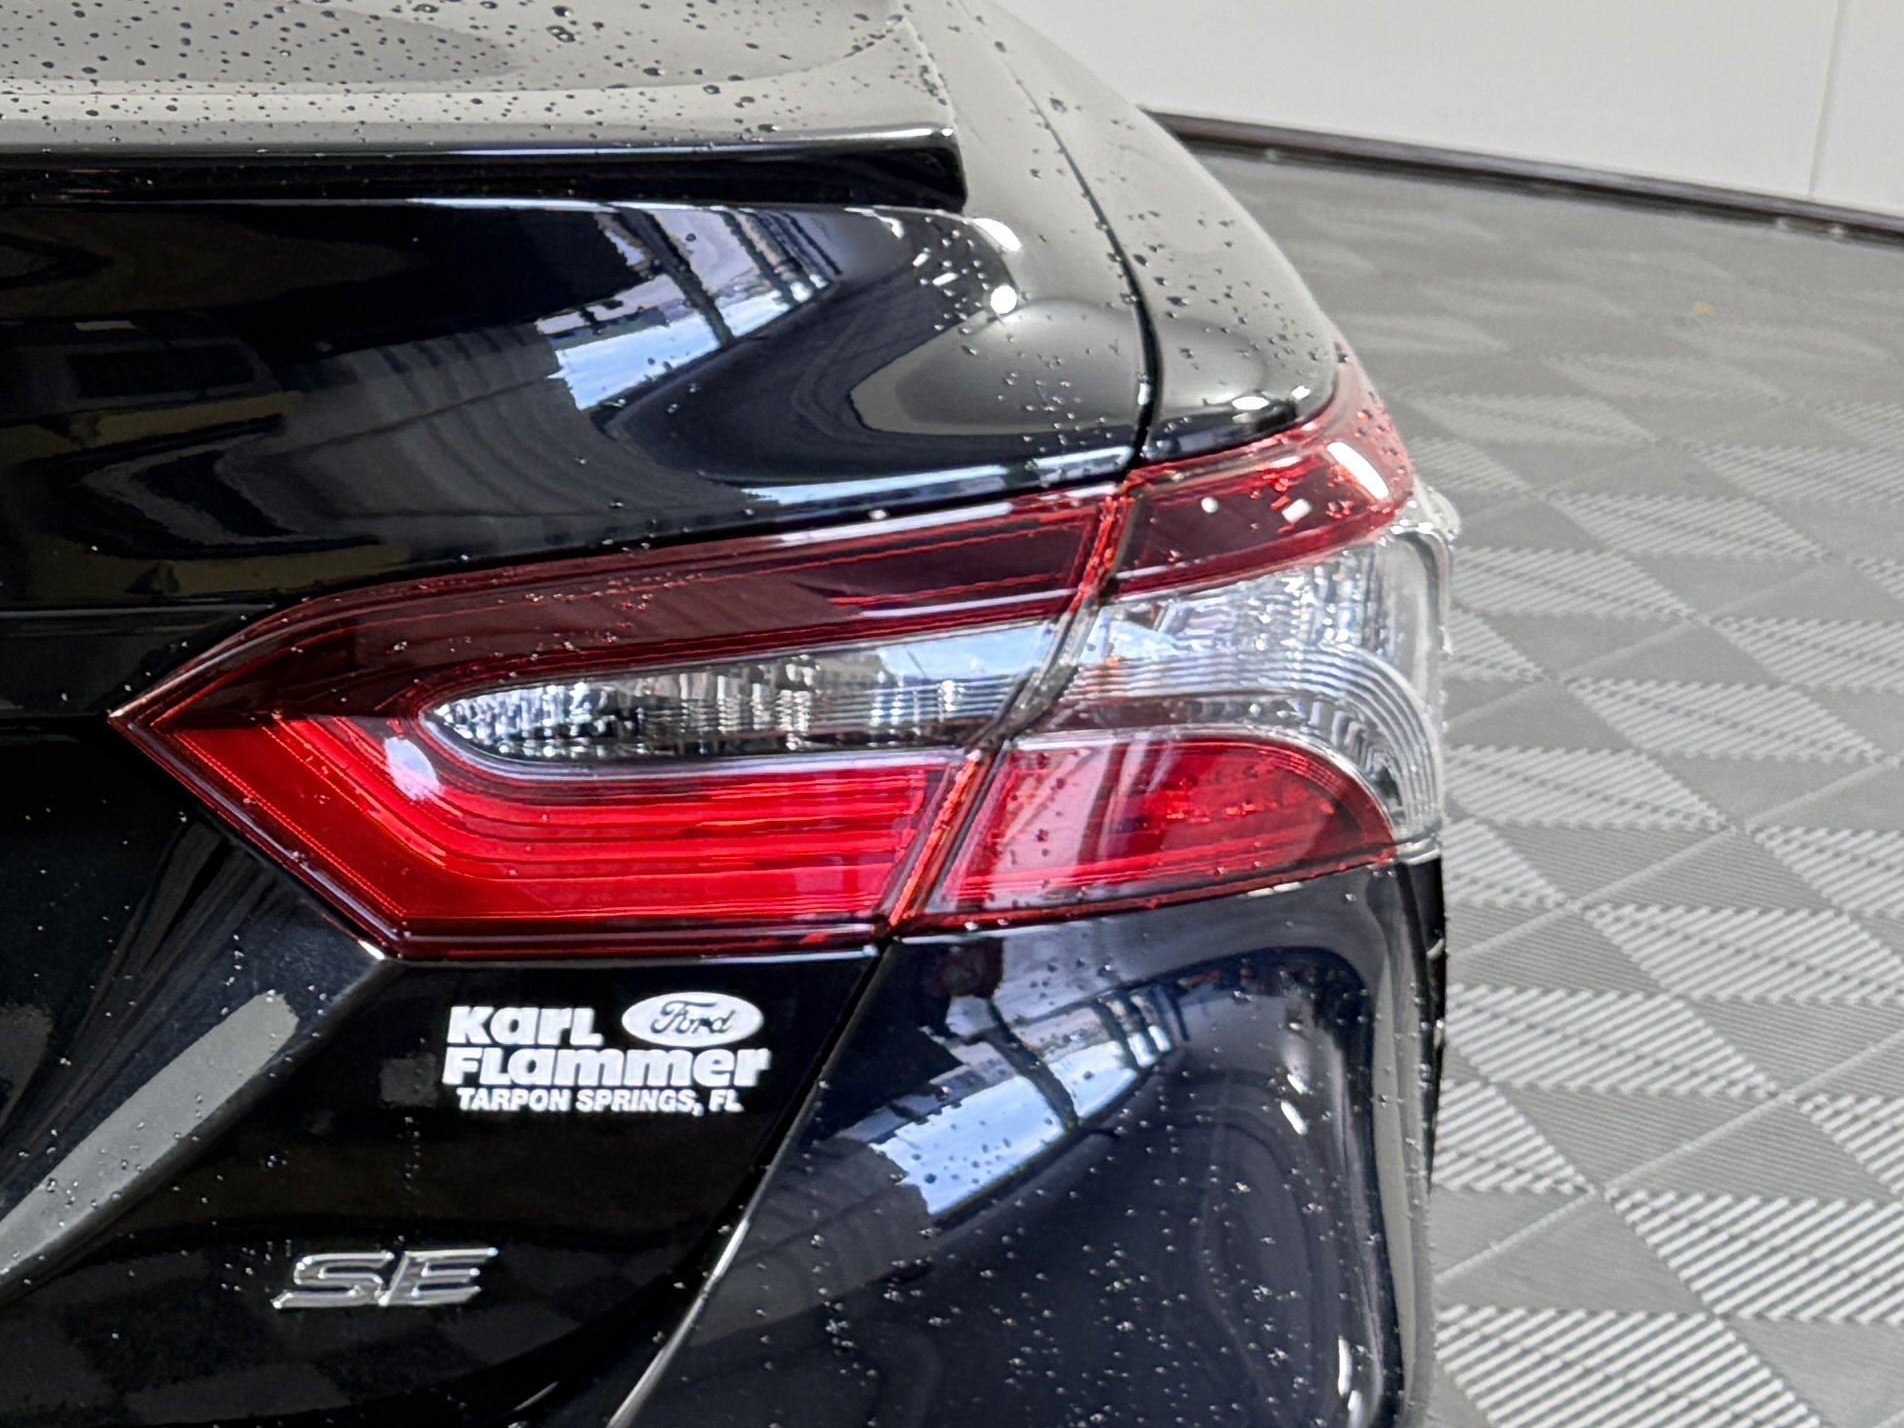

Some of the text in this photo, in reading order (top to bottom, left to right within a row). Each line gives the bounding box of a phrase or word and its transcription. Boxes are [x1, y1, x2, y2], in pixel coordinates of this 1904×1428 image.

[649, 999, 737, 1036] Ford
[456, 1089, 744, 1117] TARPON SPRINGS, FL
[269, 1247, 499, 1309] SE
